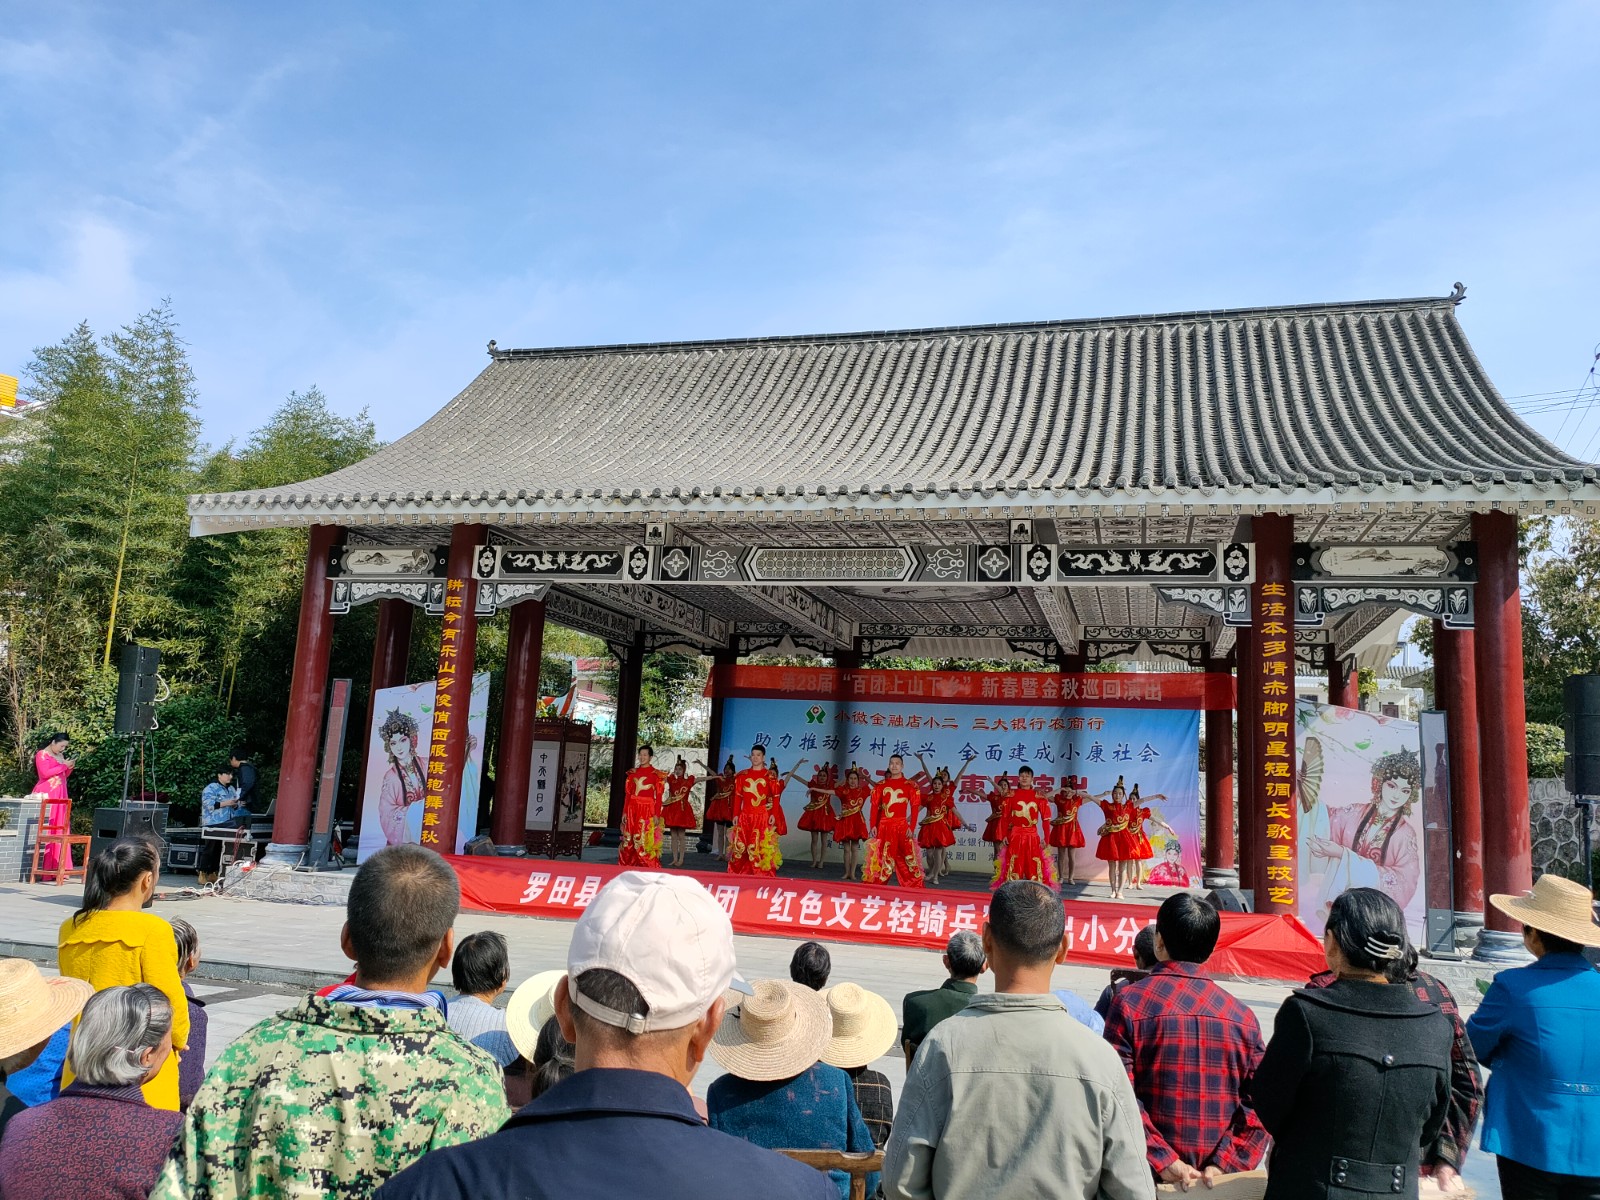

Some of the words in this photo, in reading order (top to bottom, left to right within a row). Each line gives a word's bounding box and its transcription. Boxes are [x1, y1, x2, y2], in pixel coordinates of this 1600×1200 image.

[780, 672, 833, 694] 第28届
[981, 676, 1163, 702] 新春暨金秋巡回演出
[834, 709, 959, 730] 小微金融店小二
[972, 716, 1106, 732] 三大银行农商行
[752, 731, 937, 758] 助力推动乡村振兴
[958, 741, 1161, 764] 全面建成小康社会
